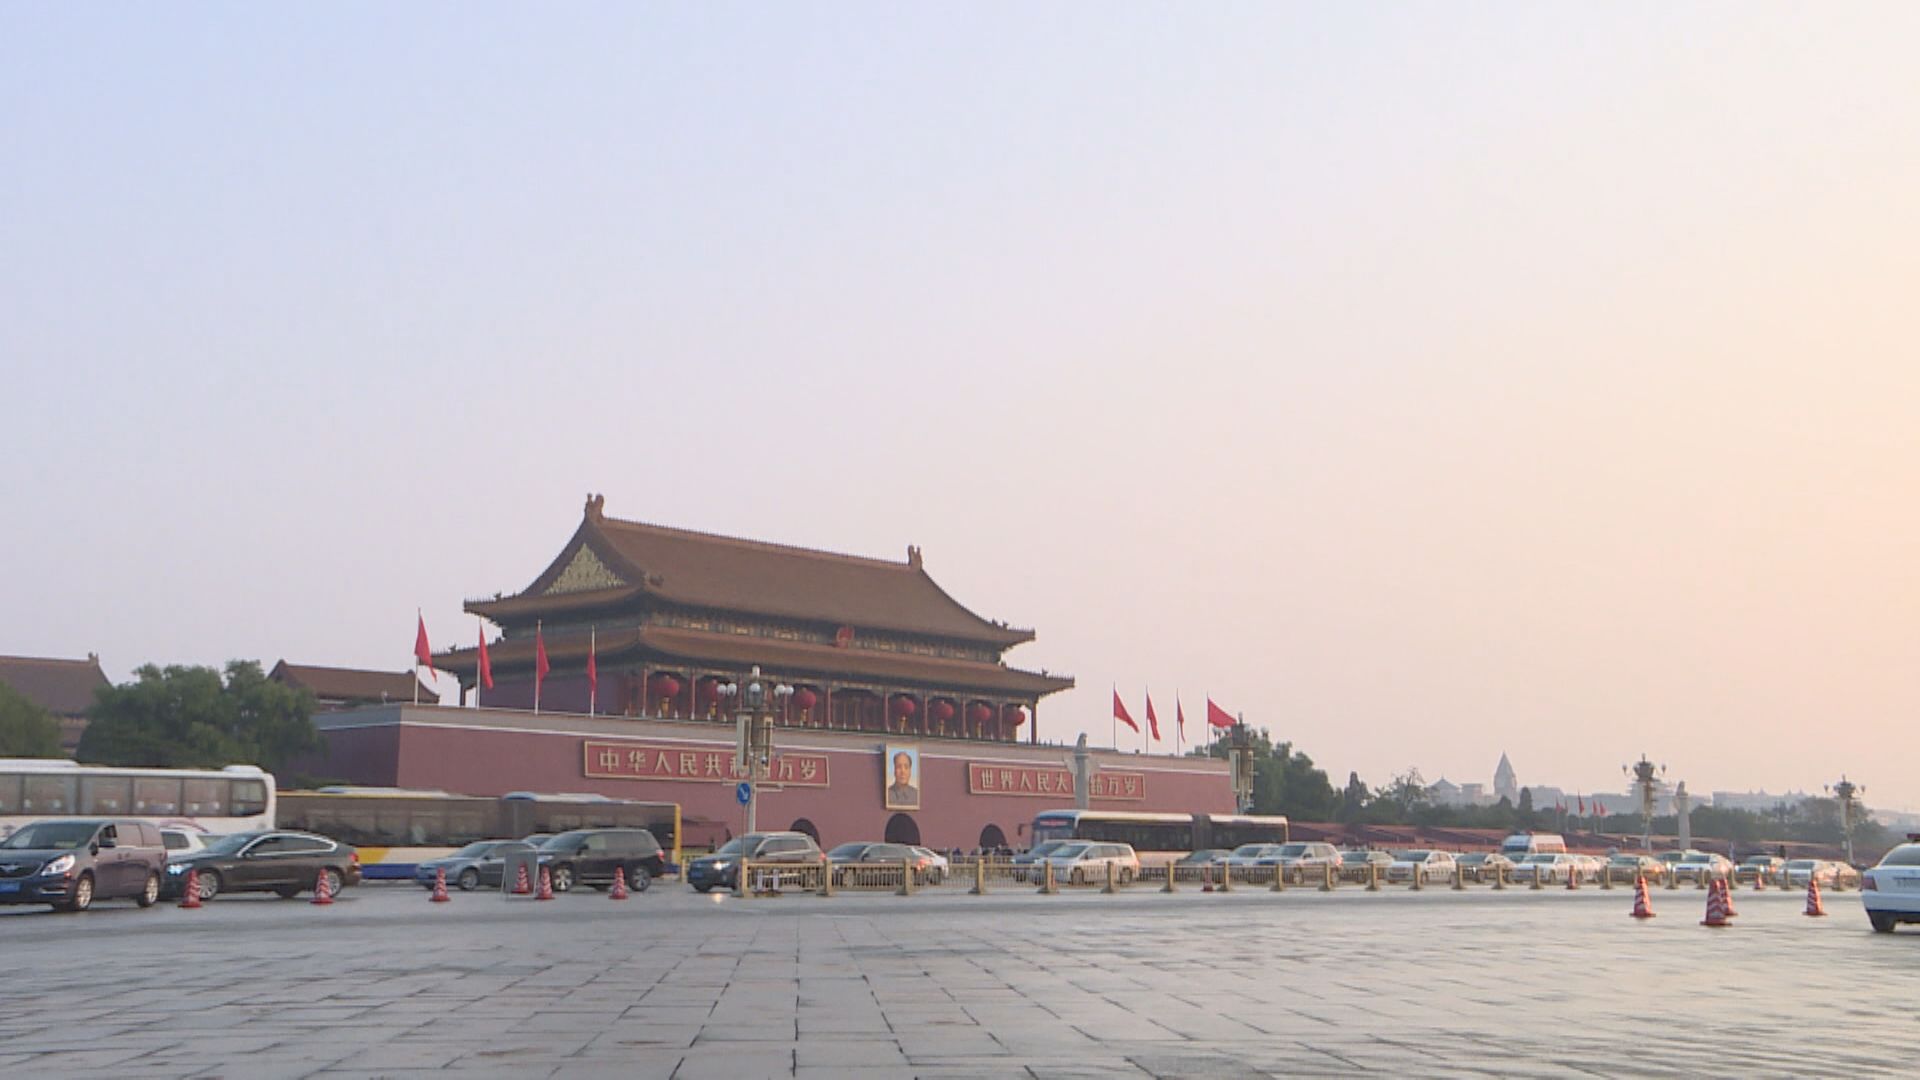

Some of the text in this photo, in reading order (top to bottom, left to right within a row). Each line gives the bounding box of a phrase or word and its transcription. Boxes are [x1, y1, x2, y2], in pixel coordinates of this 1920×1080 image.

[981, 769, 1136, 795] 世界人民大结万岁
